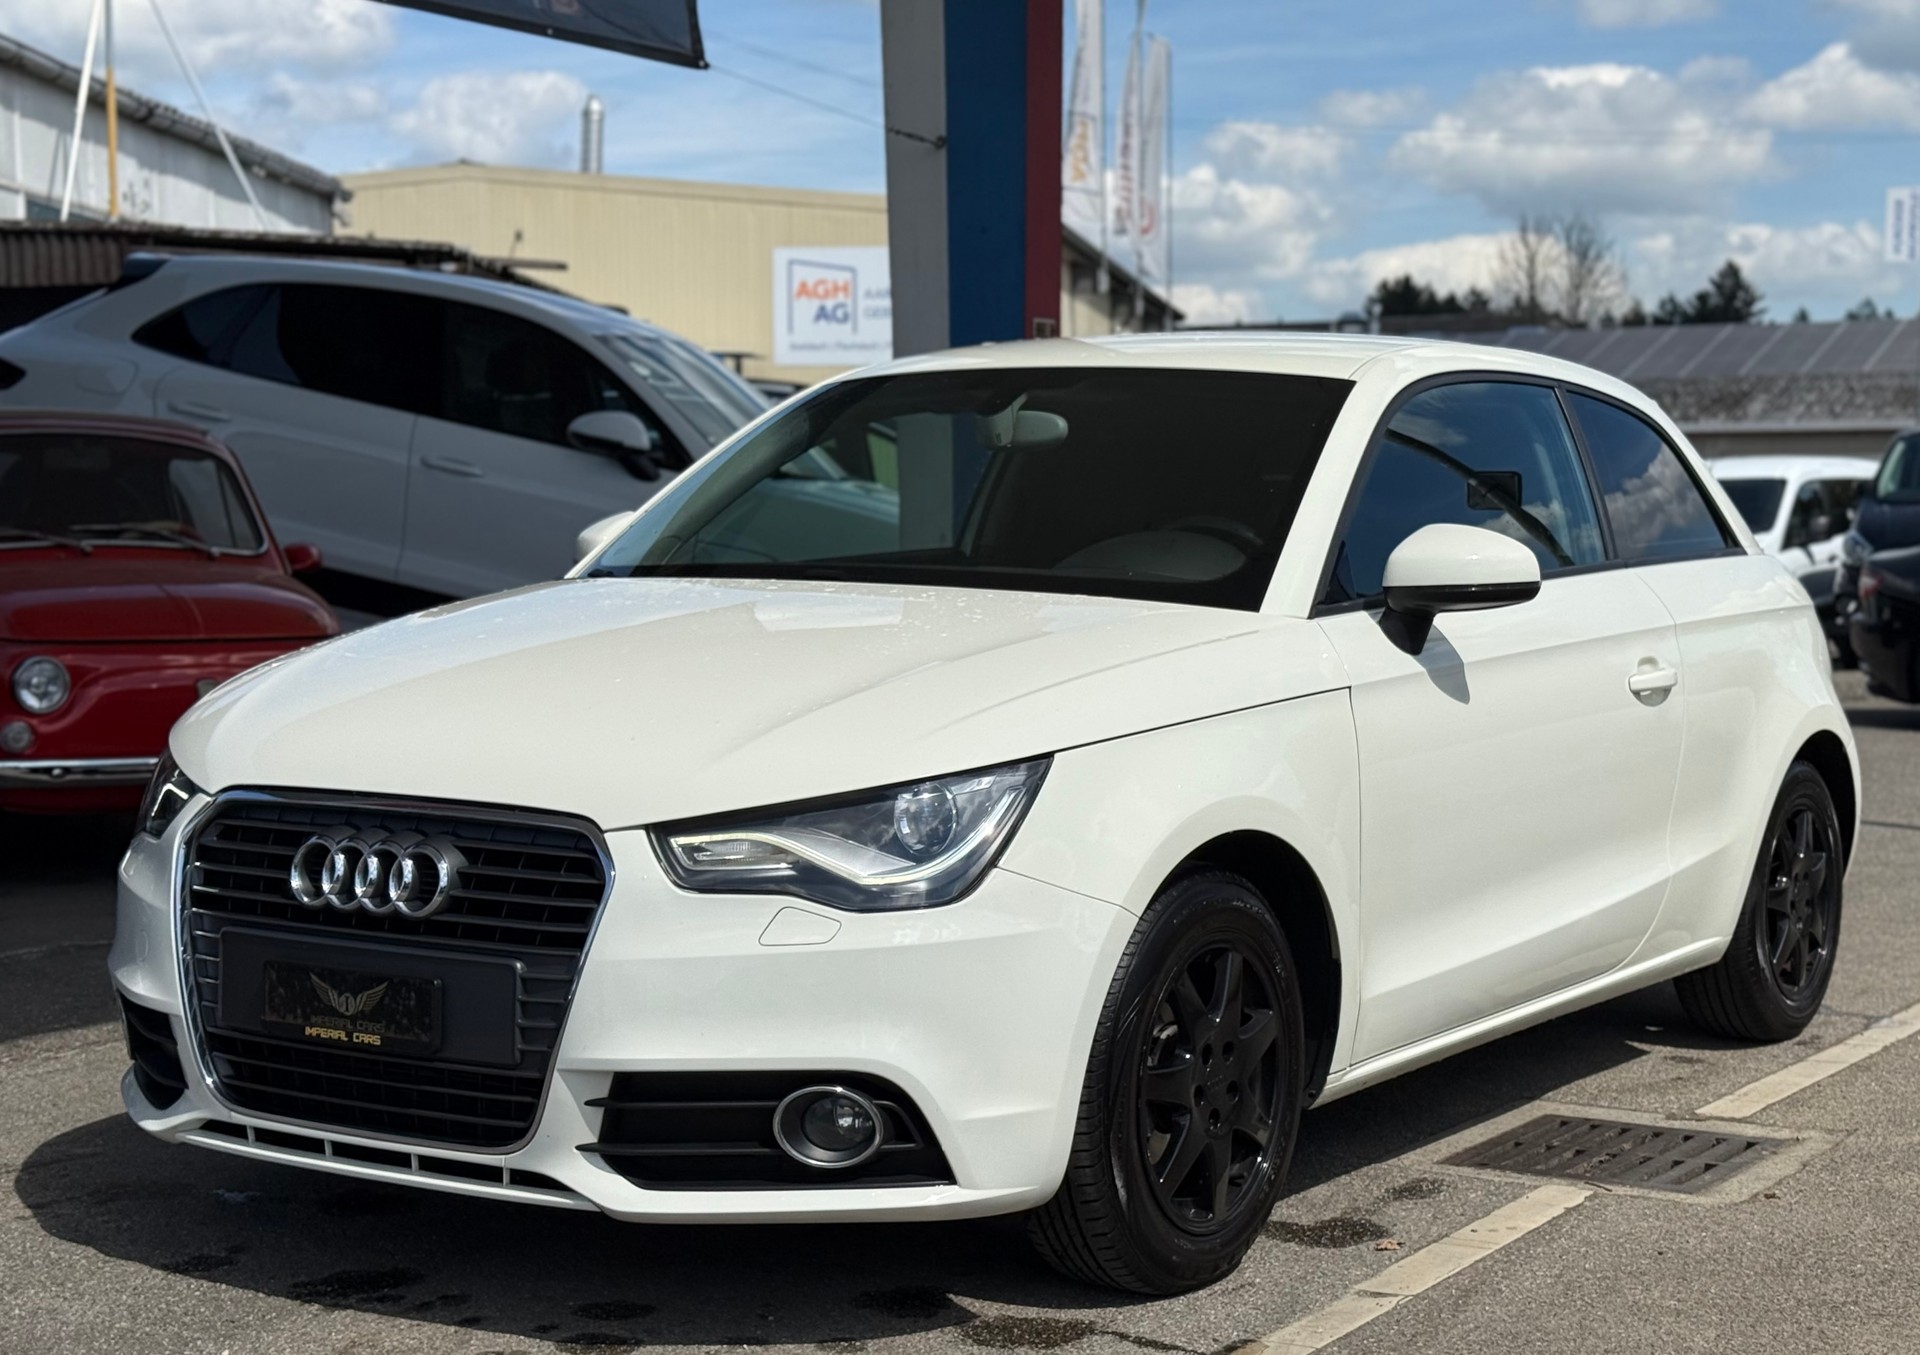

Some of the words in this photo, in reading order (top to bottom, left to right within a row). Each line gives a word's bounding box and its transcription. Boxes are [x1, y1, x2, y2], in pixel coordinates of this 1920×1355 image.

[794, 279, 850, 300] AGH
[814, 302, 849, 324] AG
[305, 1026, 349, 1041] IMPERIAL
[353, 1031, 381, 1045] CARS
